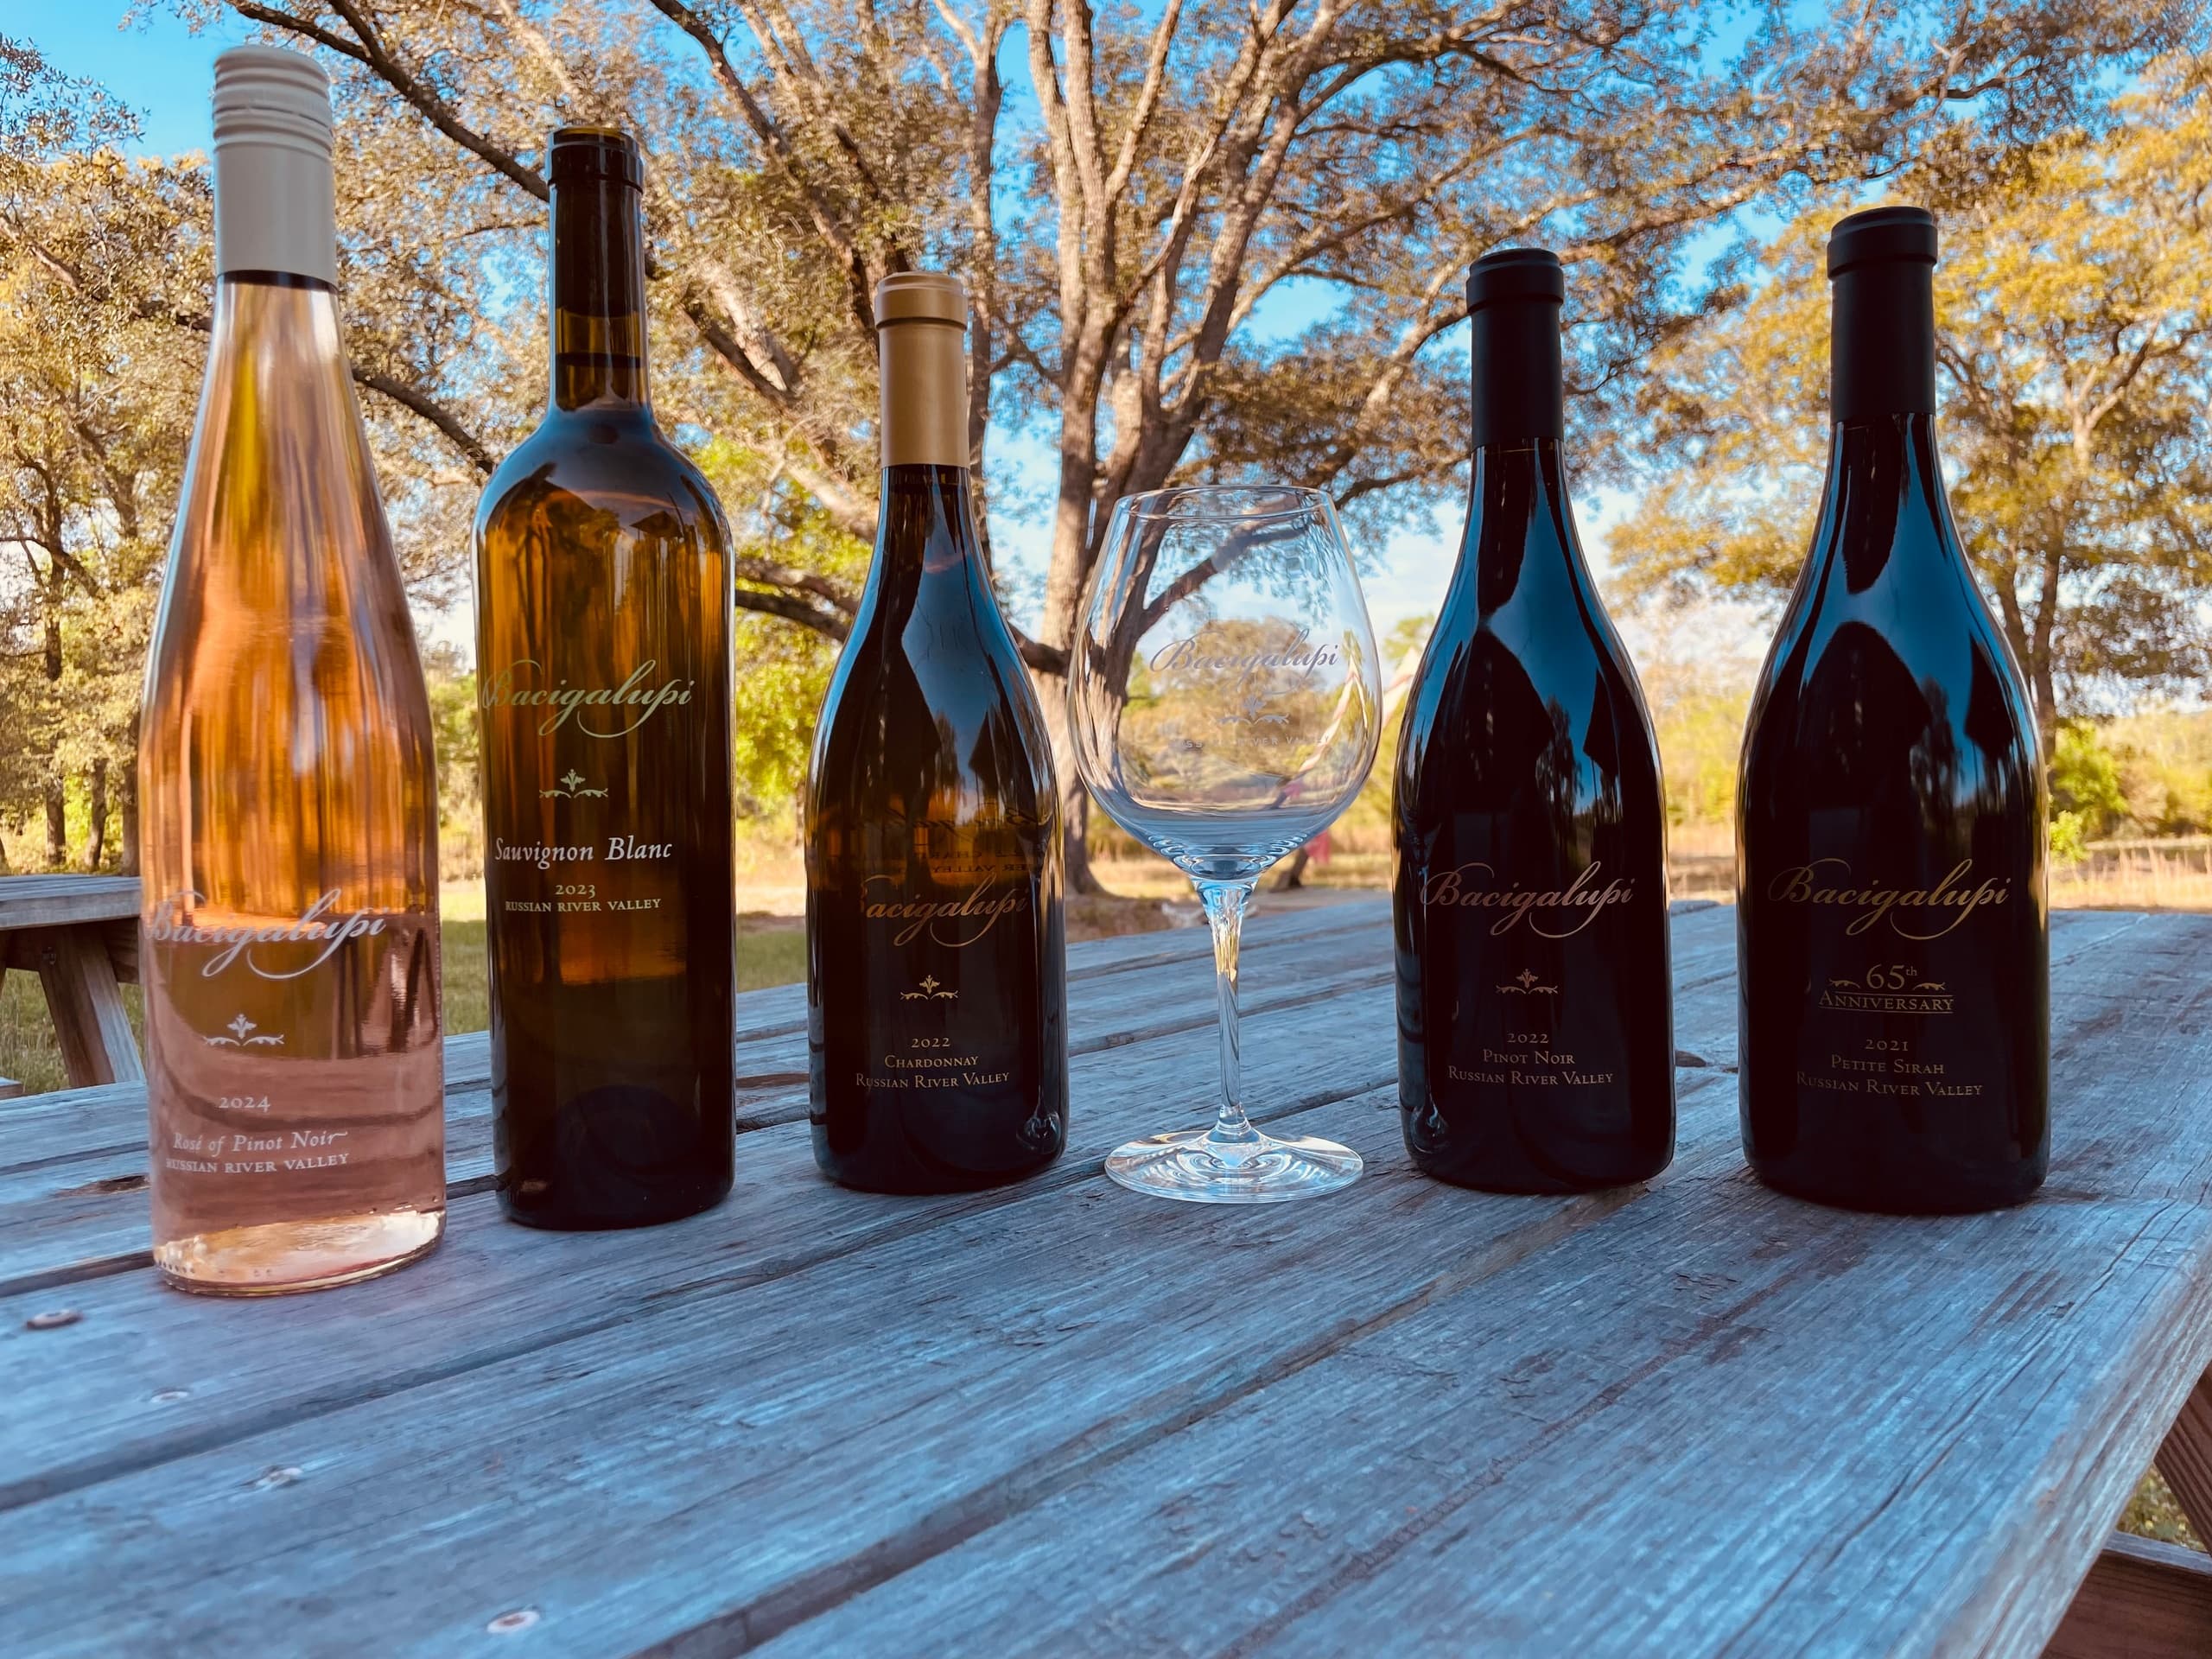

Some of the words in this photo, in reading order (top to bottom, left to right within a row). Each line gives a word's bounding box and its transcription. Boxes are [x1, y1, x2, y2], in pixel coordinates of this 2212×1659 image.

[1149, 628, 1338, 695] Bacigalupi
[482, 659, 695, 738] Bacigalupi
[494, 837, 594, 869] Sauvignon
[604, 835, 672, 861] Blanc
[505, 900, 552, 912] RUSSIAN
[557, 901, 602, 912] RIVER
[607, 898, 662, 911] VALLEY
[556, 884, 596, 899] 2023
[1419, 861, 1636, 938] Bacigalupi
[1767, 858, 2012, 940] Bacigalupi
[144, 888, 390, 980] Bacigalupi
[1866, 963, 1918, 990] 65th
[911, 1038, 950, 1048] 2022
[1507, 1033, 1549, 1044] 2022
[1866, 1039, 1909, 1052] 2021
[218, 1096, 271, 1113] 2024
[173, 1132, 203, 1151] Rosé
[208, 1135, 226, 1157] of
[232, 1134, 283, 1152] Pinot
[290, 1130, 349, 1149] Noir
[165, 1157, 218, 1173] RUSSIAN
[225, 1160, 277, 1174] RIVER
[283, 1153, 350, 1170] VALLEY
